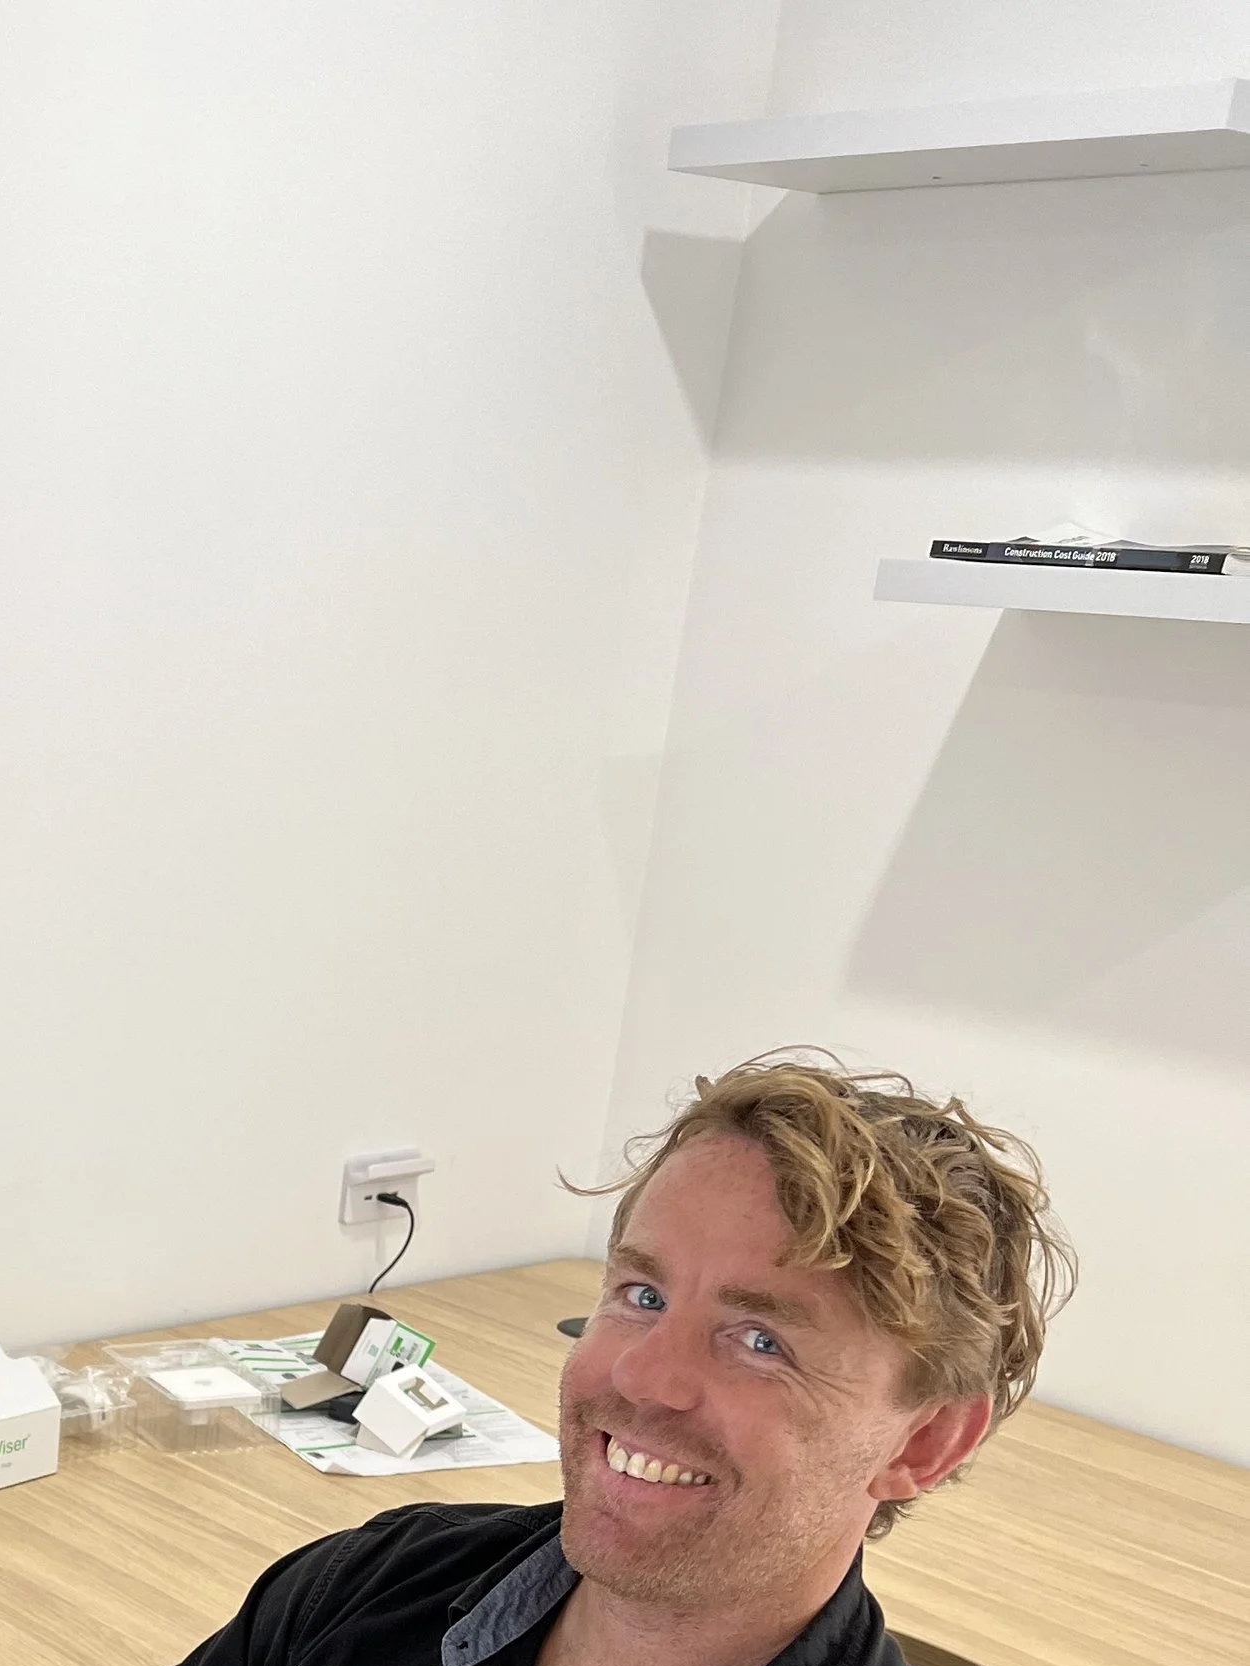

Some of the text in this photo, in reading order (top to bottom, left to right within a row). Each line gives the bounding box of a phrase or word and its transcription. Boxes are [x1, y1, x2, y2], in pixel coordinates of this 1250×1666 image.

[1004, 547, 1052, 559] Construction
[1054, 550, 1072, 560] Cost
[1072, 550, 1095, 561] Guide
[1095, 551, 1117, 562] 2018
[1191, 555, 1210, 564] 2018
